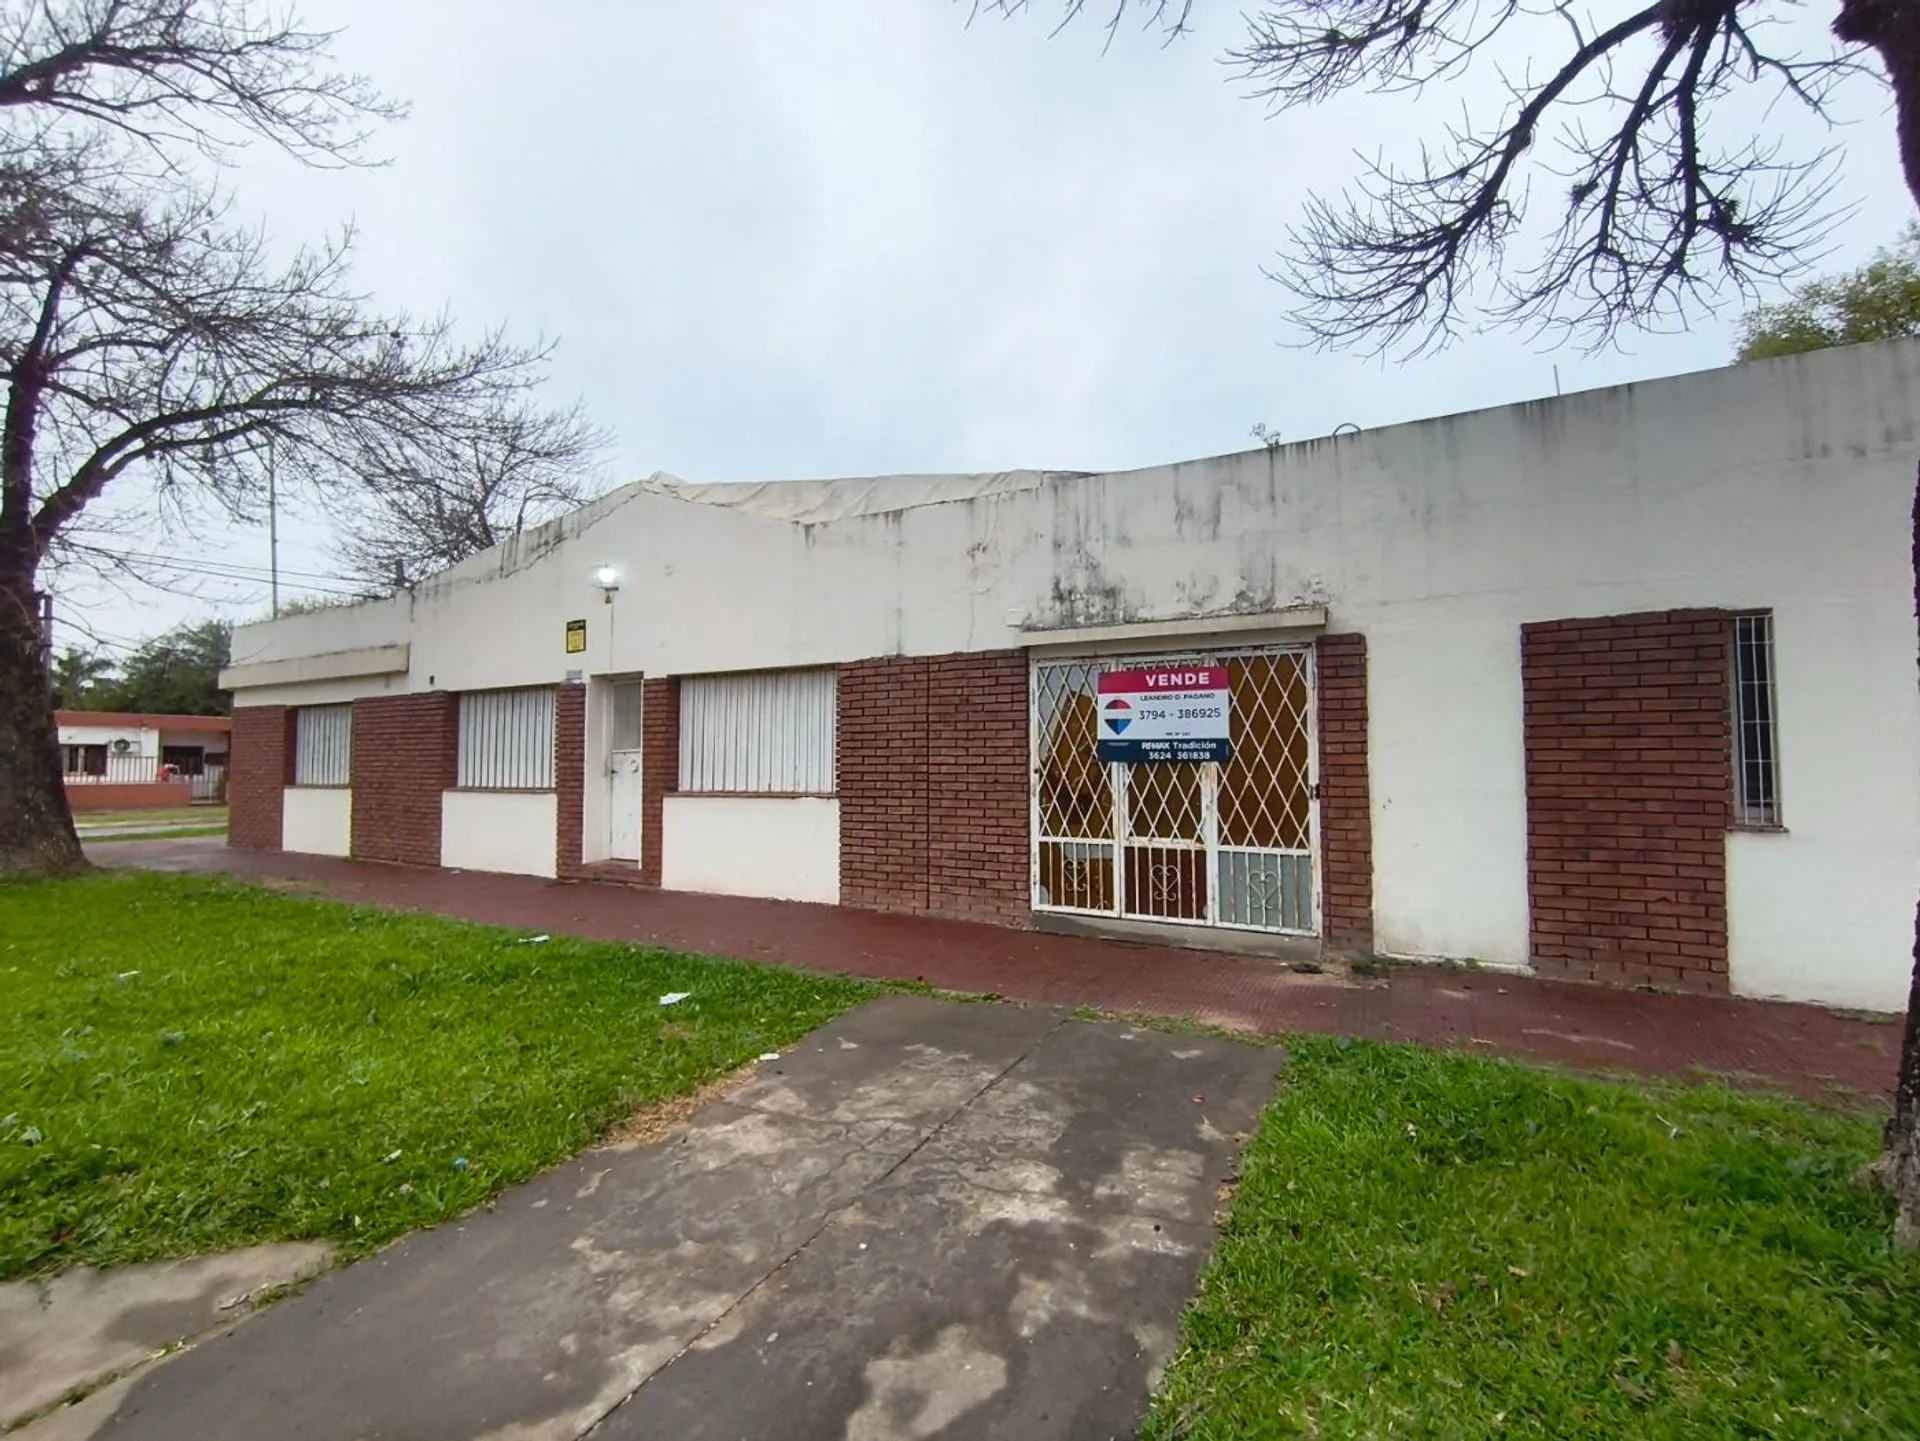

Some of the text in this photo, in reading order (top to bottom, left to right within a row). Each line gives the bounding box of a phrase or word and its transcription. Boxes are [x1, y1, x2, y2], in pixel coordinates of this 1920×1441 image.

[1145, 672, 1210, 687] VENDE
[1139, 710, 1166, 720] 3794
[1177, 708, 1221, 719] 386925
[1172, 741, 1217, 750] Tradición
[1148, 751, 1171, 760] 3624
